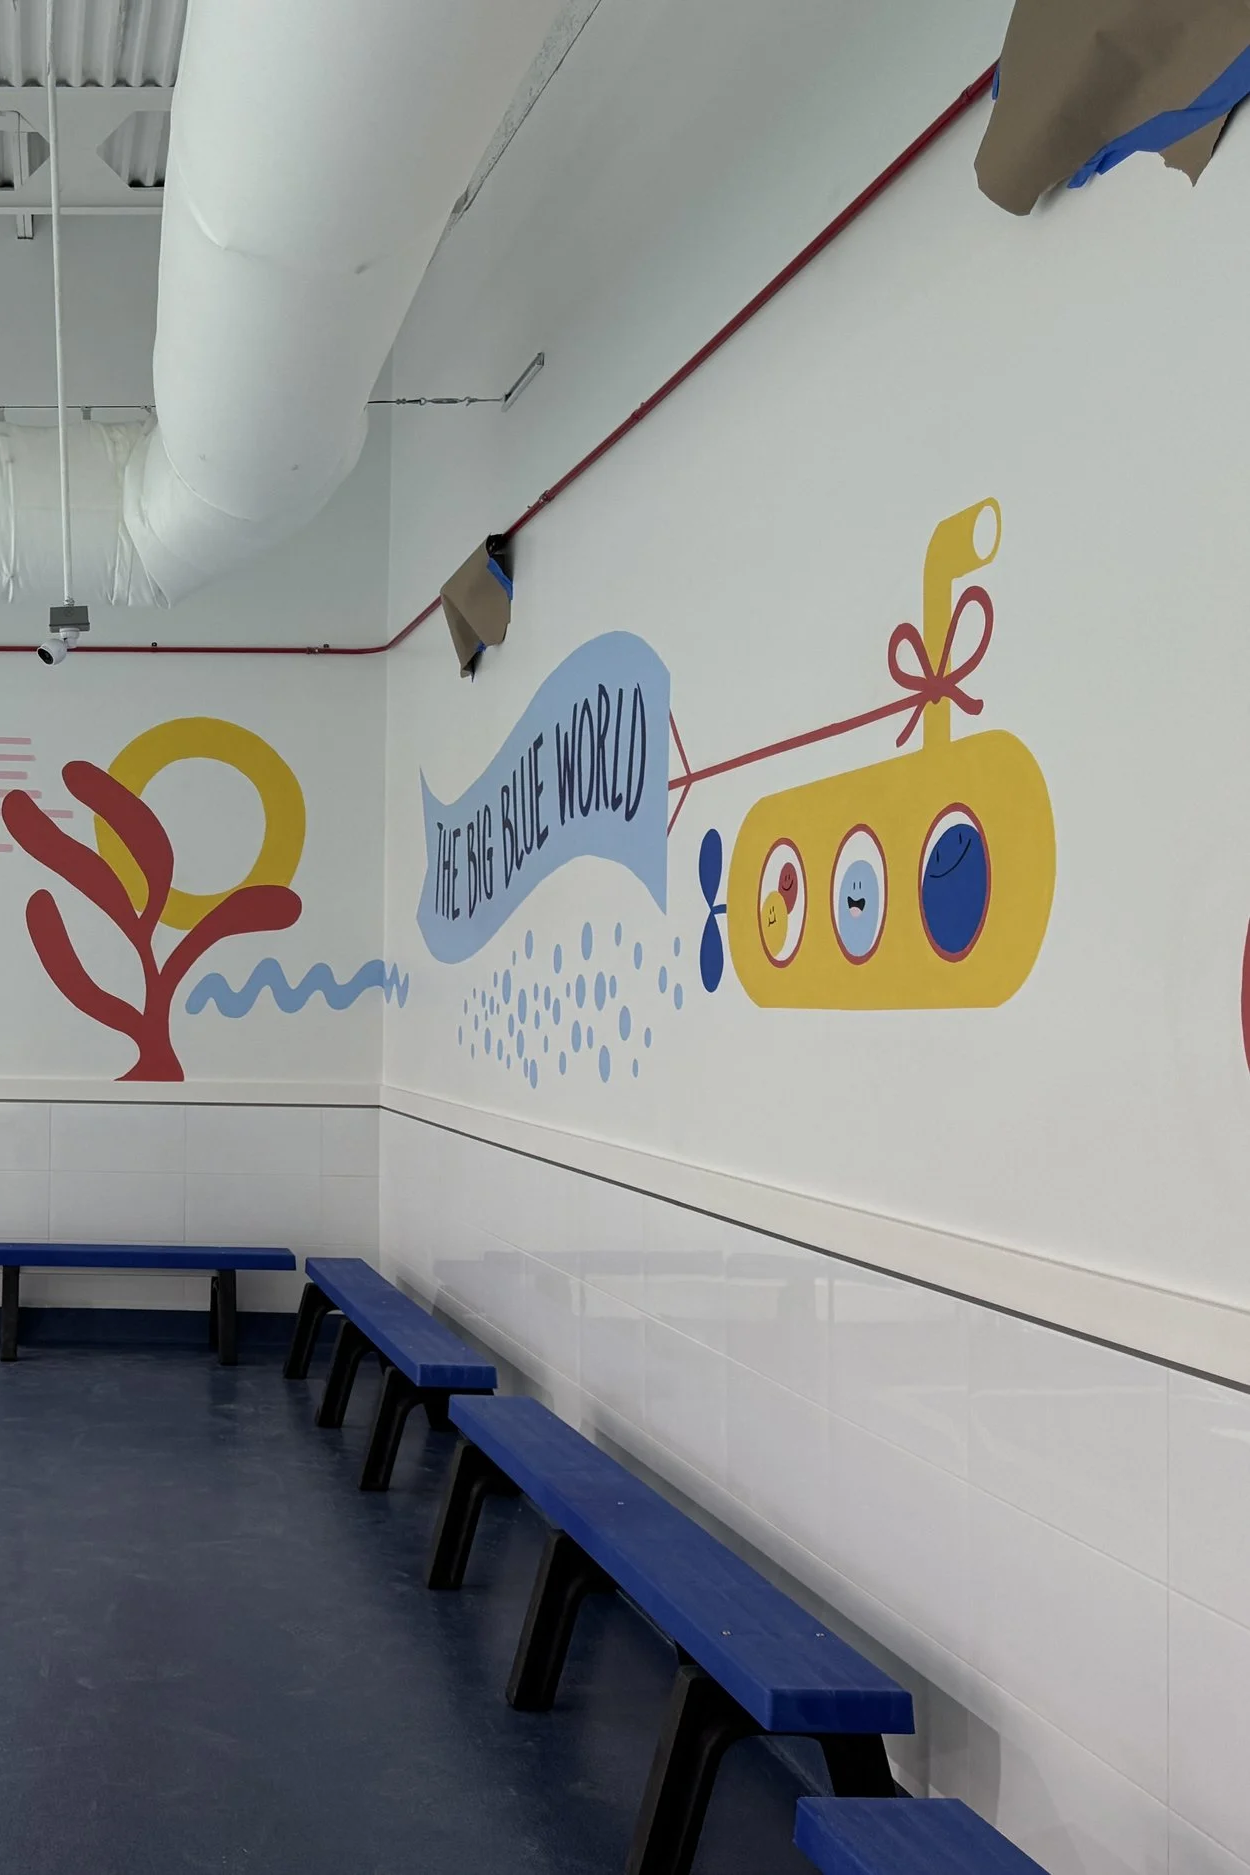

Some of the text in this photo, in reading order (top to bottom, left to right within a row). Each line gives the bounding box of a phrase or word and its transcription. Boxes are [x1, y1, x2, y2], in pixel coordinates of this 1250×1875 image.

[435, 682, 647, 921] THE BIG BLUE WORLD
